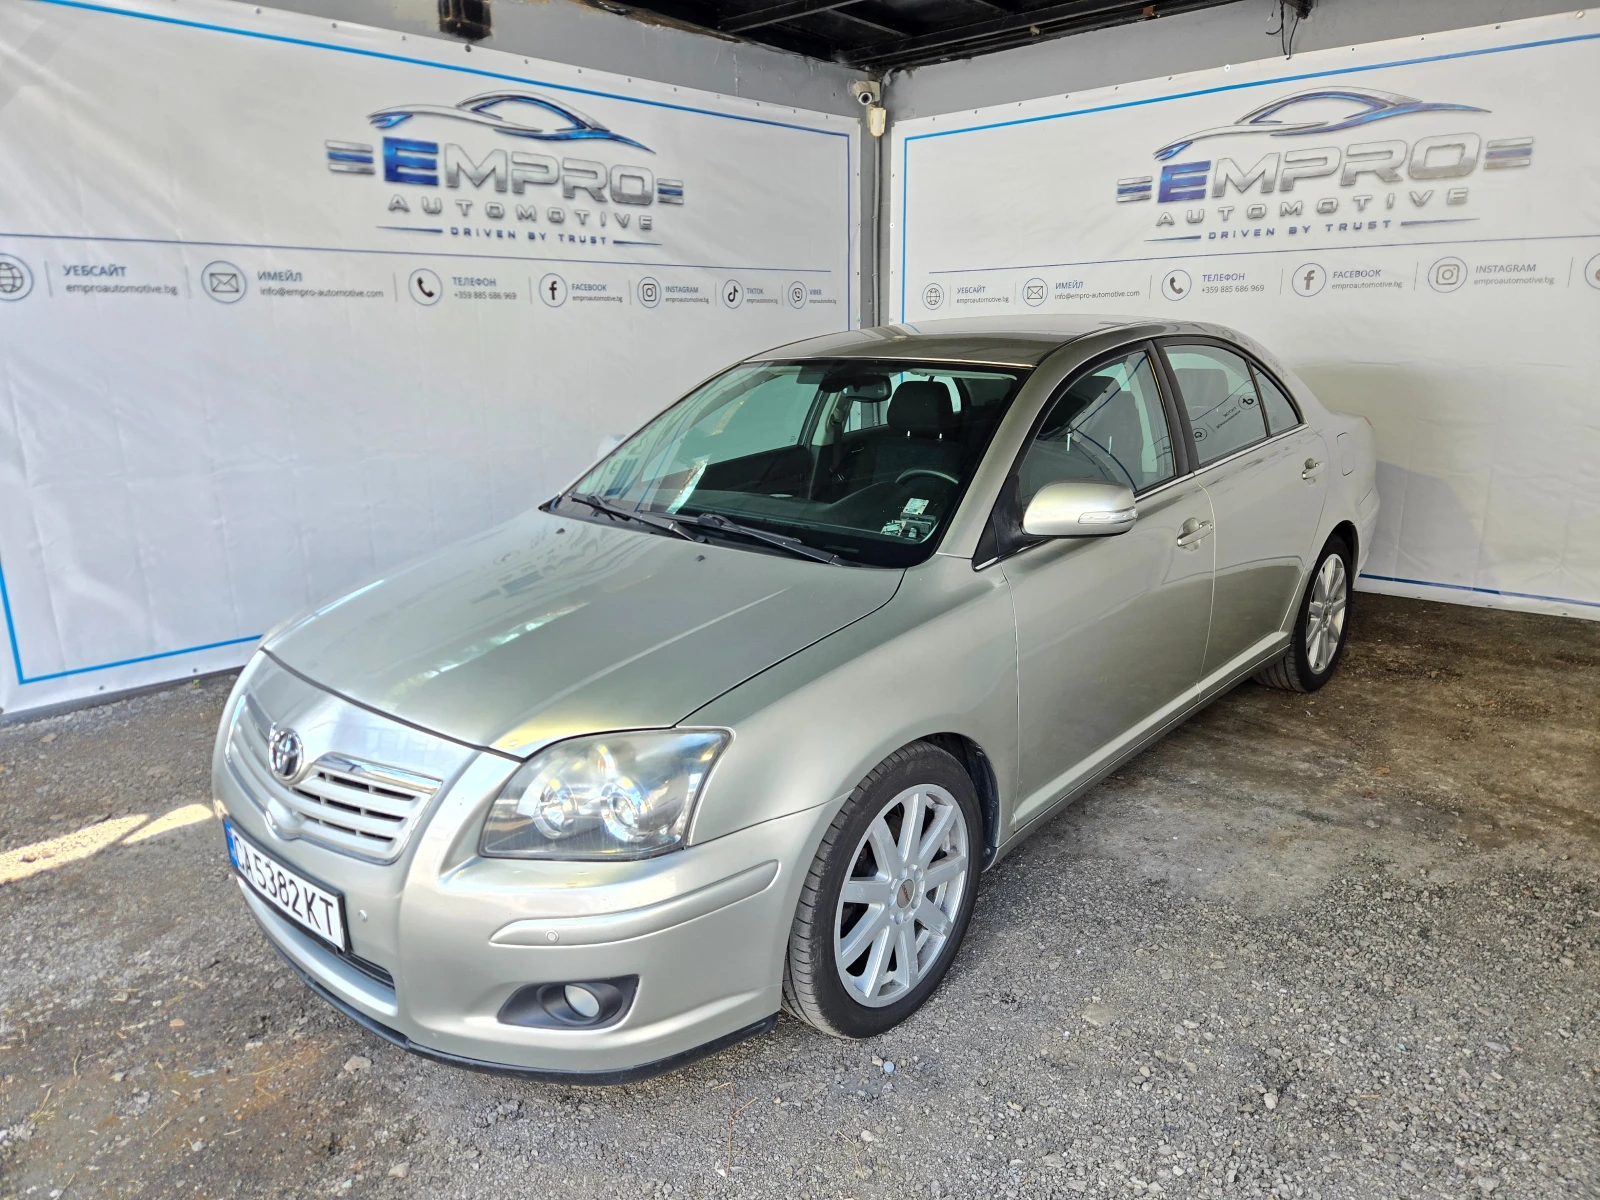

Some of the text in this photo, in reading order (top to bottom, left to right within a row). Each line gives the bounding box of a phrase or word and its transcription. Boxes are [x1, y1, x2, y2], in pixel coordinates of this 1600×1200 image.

[383, 136, 654, 205] EMPRO
[1157, 132, 1482, 204] EMPRO
[387, 194, 653, 230] AUTOMOTIVE
[1156, 188, 1469, 227] AUTOMOTIVE
[1208, 219, 1393, 240] DRIVEN BY TRUST
[451, 227, 607, 245] DRIVEN BY TRUST
[63, 264, 127, 277] УЕБСАЙТ
[1333, 269, 1381, 279] FACEBOOK
[1475, 263, 1537, 274] INSTAGRAM
[257, 269, 303, 282] ИМЕЙЛ
[1202, 272, 1246, 282] ТЕЛЕФОН
[1473, 274, 1555, 285] emproautomotive.bg
[452, 276, 497, 287] ТЕЛЕФОН
[1055, 281, 1083, 290] ИМЕЙЛ
[1331, 279, 1403, 290] emproautomotive.bg
[66, 284, 178, 296] emproautomotive.bg
[260, 287, 384, 298] info@empro-automotive.com
[571, 283, 607, 292] FACEBOOK
[746, 287, 764, 295] TIKTOK
[956, 286, 986, 294] УЕБСАЙТ
[1201, 284, 1265, 294] +359 885 686 969
[1054, 290, 1140, 301] info@empro-automotive.com
